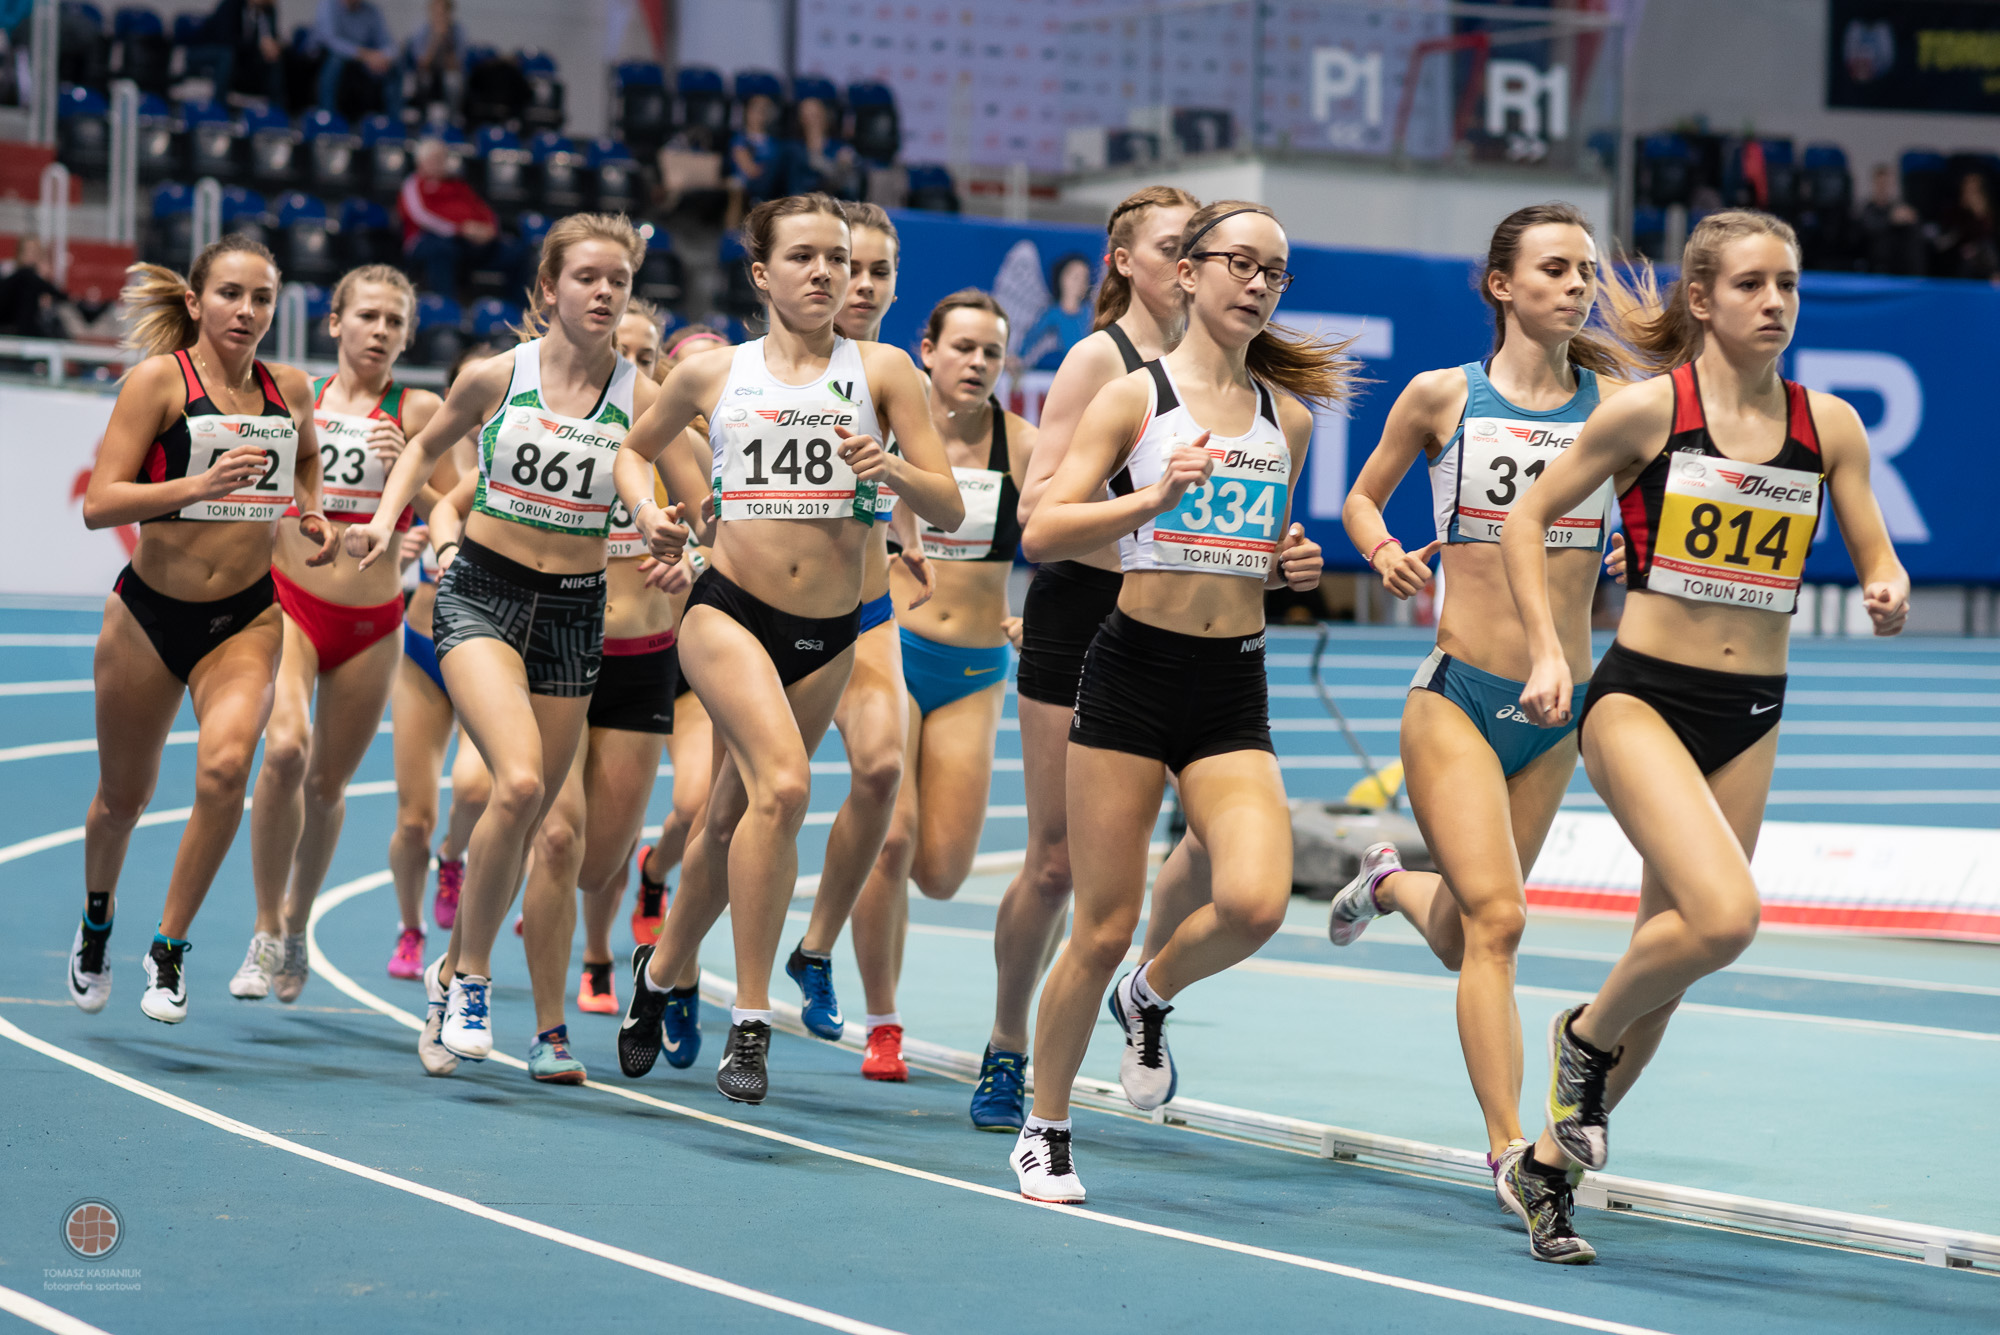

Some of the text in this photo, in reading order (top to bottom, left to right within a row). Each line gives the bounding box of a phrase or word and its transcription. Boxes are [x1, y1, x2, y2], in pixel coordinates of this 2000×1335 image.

[1312, 46, 1383, 124] P1
[1487, 59, 1569, 139] R1
[1472, 435, 1499, 443] TOYOTA
[511, 443, 596, 500] 861
[743, 438, 833, 485] 148
[207, 503, 274, 518] TORUŃ 2019
[330, 498, 358, 510] 2019
[509, 499, 585, 526] TORUŃ 2019
[746, 500, 830, 515] TORUŃ 2019
[1181, 477, 1275, 537] 334
[1685, 503, 1791, 571] 814
[1183, 548, 1269, 569] TORUŃ 2019
[560, 576, 596, 589] NIKE
[1683, 579, 1775, 606] TORUŃ 2019
[1240, 634, 1265, 653] NIKE
